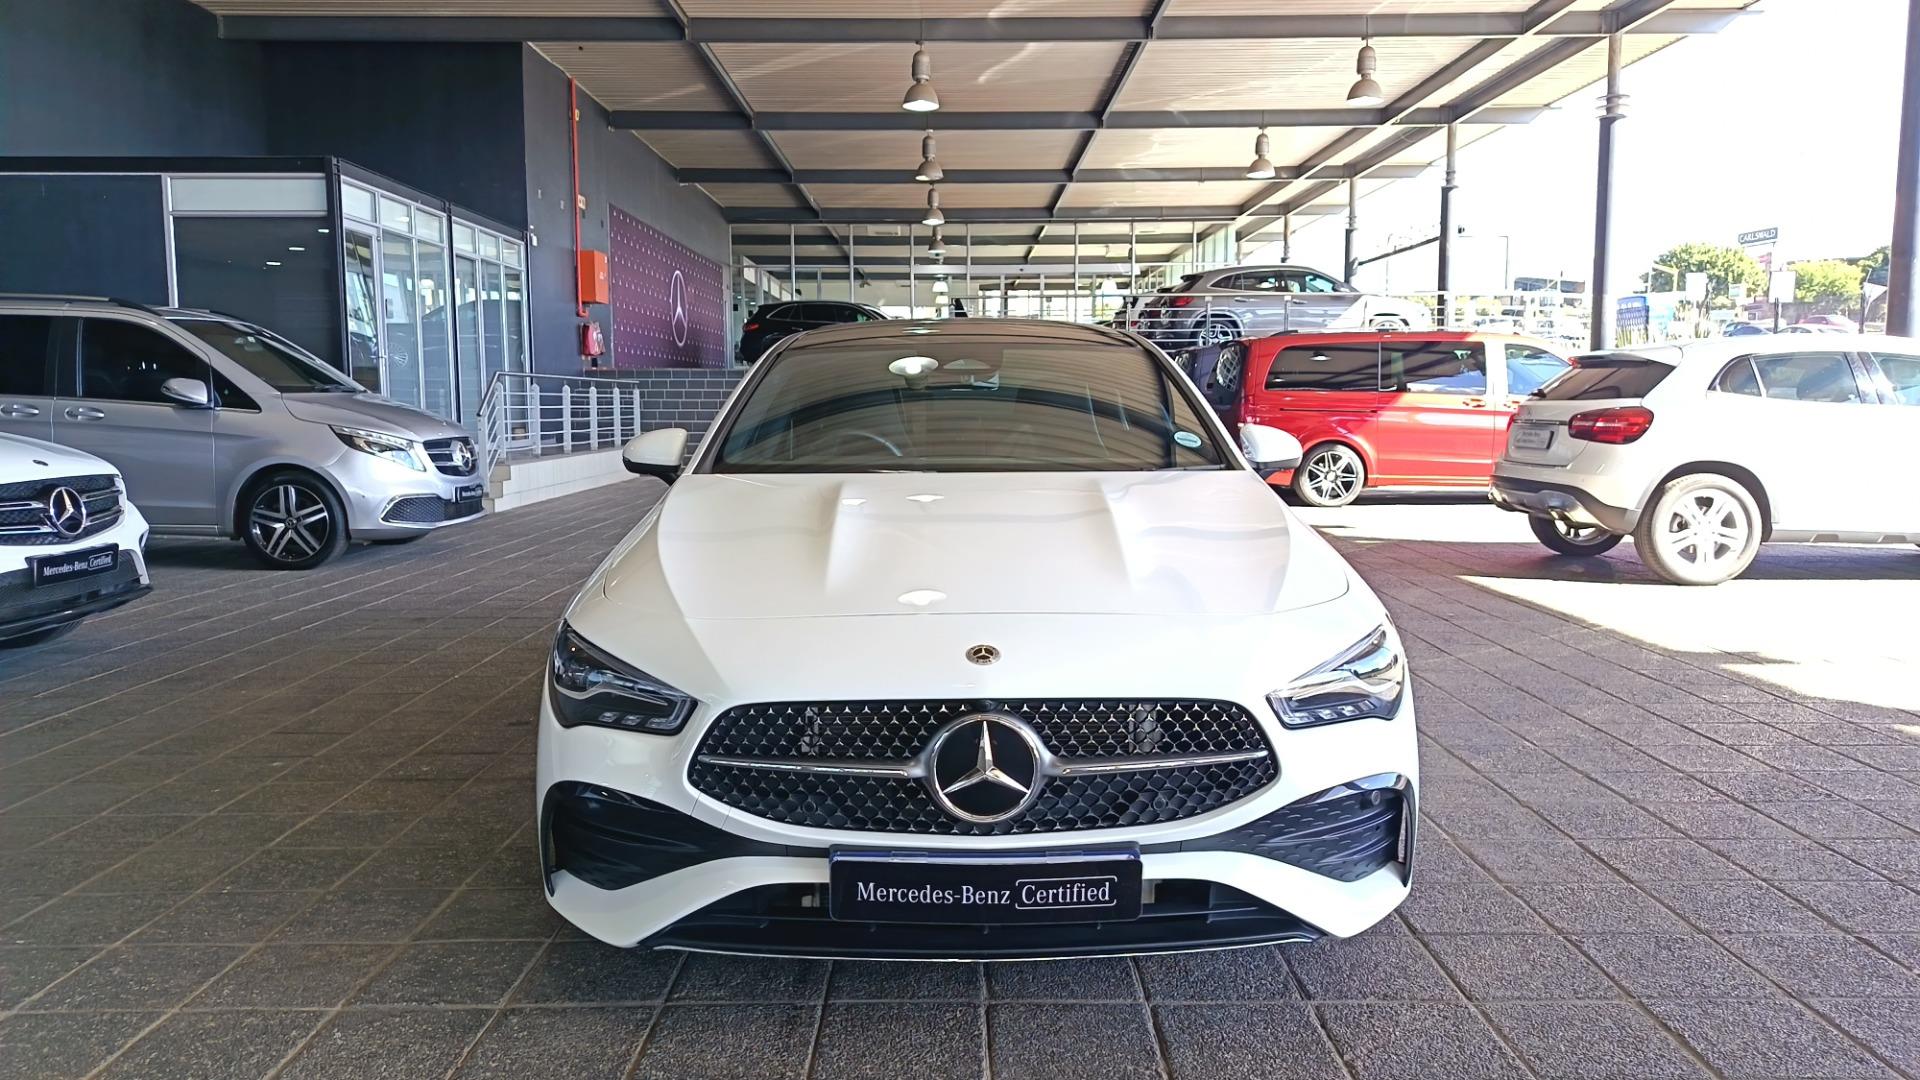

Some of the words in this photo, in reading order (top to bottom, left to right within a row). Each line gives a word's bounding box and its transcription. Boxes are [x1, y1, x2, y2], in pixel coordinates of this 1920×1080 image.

[43, 561, 88, 576] Mercedes-Benz
[857, 881, 1011, 905] Mercedes-Benz
[1021, 881, 1110, 904] Certified
